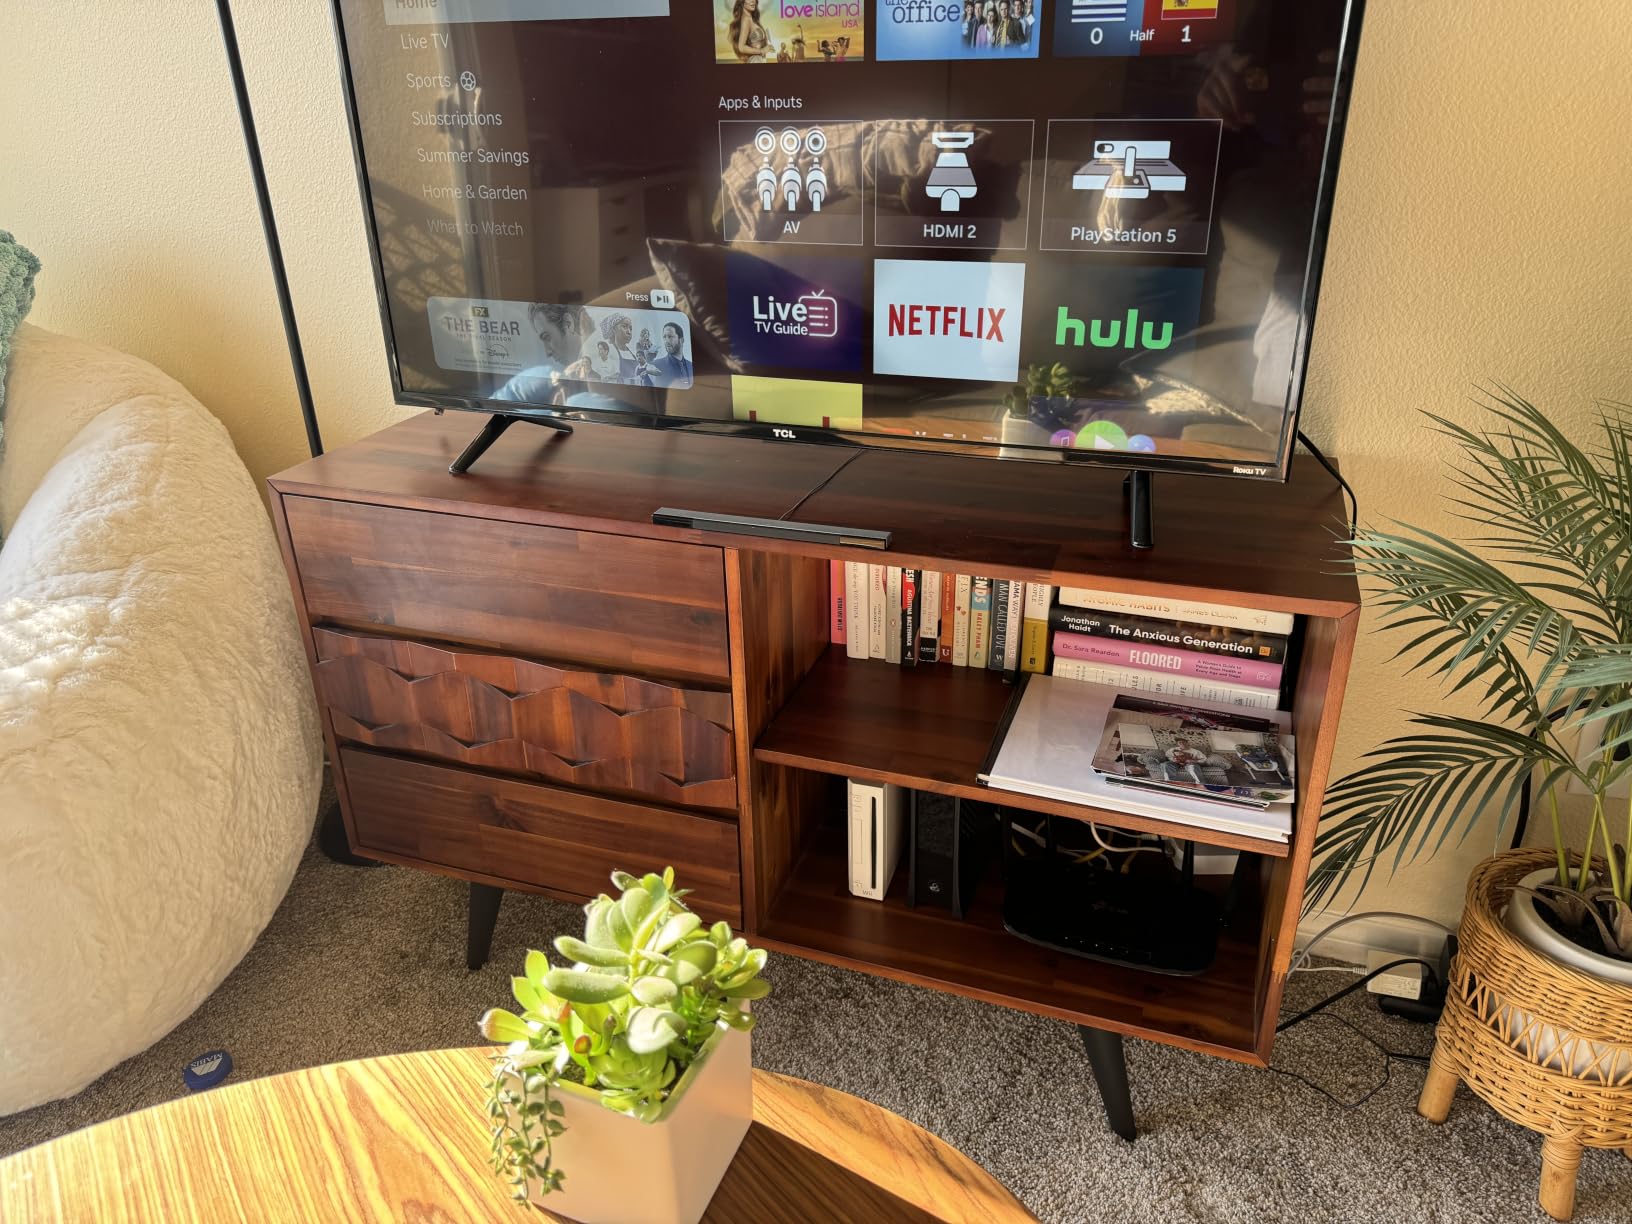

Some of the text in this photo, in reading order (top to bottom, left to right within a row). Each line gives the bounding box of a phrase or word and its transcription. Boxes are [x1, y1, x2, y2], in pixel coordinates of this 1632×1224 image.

[780, 0, 860, 18] love island
[892, 0, 961, 24] office
[841, 20, 858, 28] USA
[400, 32, 449, 49] Live TV
[1090, 25, 1192, 45] 0 Half 1
[406, 72, 451, 90] Sports
[718, 94, 803, 111] Apps & Inputs
[412, 110, 503, 128] Subscriptions
[417, 148, 530, 167] Summer Savings
[422, 184, 528, 200] Home & Garden
[426, 218, 524, 237] What to Watch
[782, 220, 801, 234] AV
[923, 224, 976, 239] HDMI 2
[1070, 226, 1177, 248] PlayStation 5
[626, 292, 649, 302] Press
[753, 295, 808, 322] Live
[444, 316, 521, 336] THE BEAR
[754, 321, 808, 336] TV Guide
[888, 303, 1007, 343] NETFLIX
[1055, 306, 1174, 350] hulu
[772, 428, 796, 439] TCL
[1232, 466, 1267, 476] Roku TV
[906, 568, 914, 582] ESH
[974, 576, 988, 603] ENDS
[999, 583, 1008, 602] MAN
[1012, 581, 1022, 599] AMA
[976, 612, 984, 631] HALEY
[997, 604, 1007, 632] CALLED
[1061, 616, 1100, 627] Jonathan
[1068, 623, 1092, 632] Haidt
[1108, 624, 1131, 636] The
[1133, 628, 1180, 644] Anxious
[1183, 635, 1254, 654] Generation
[1074, 645, 1089, 653] Sara
[1090, 648, 1120, 657] Reardon
[1130, 650, 1182, 670] FLOORED
